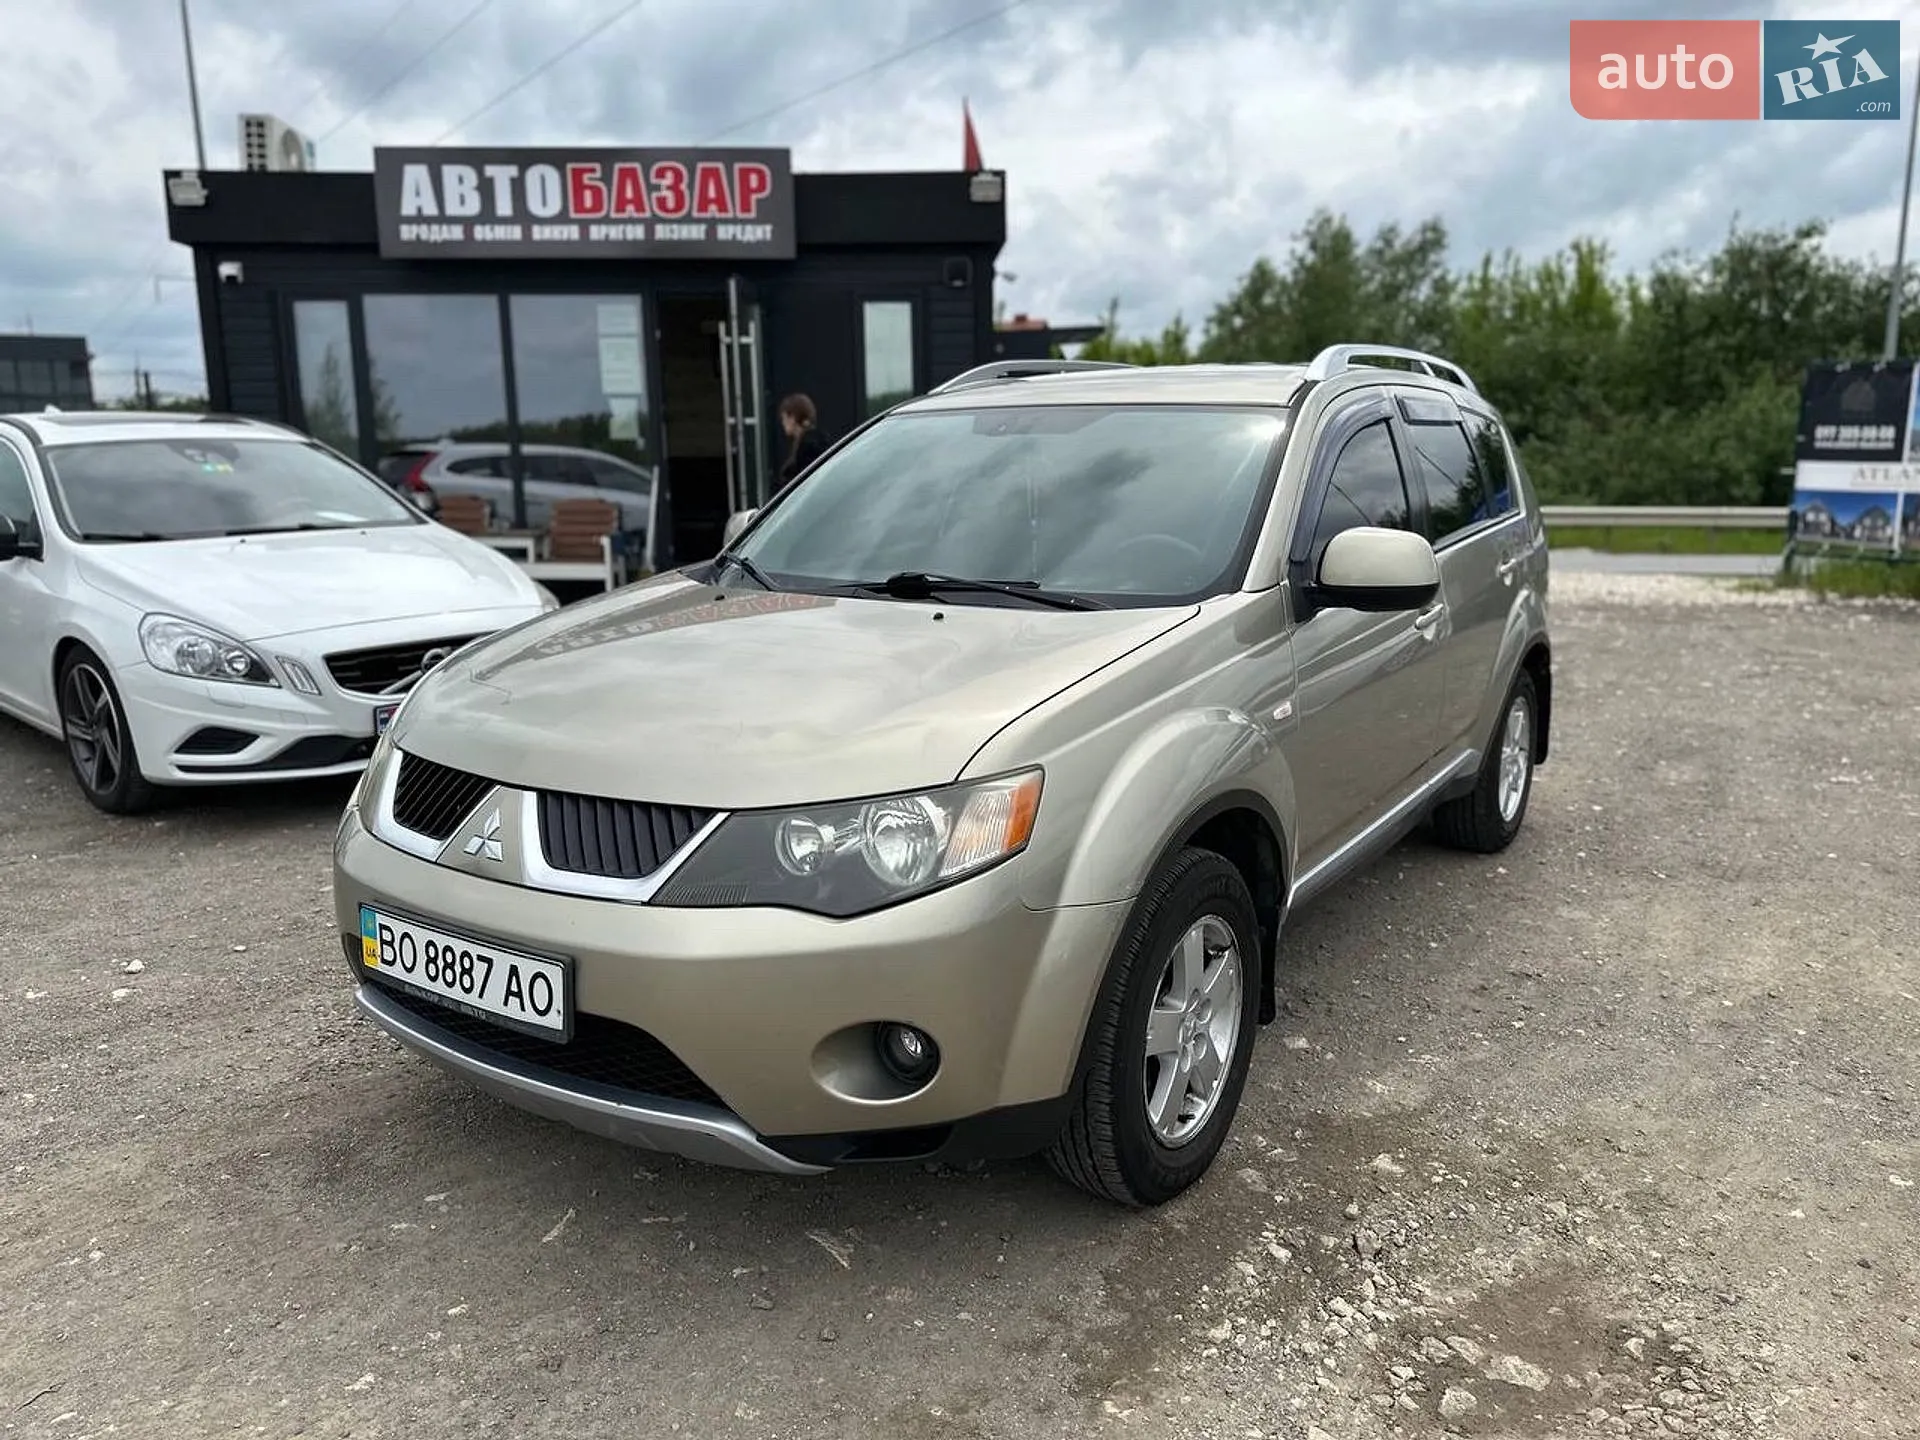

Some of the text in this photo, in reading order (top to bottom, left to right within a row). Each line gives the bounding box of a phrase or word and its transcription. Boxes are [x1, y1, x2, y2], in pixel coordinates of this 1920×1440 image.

[400, 161, 772, 219] АВТОБАЗАР
[399, 224, 465, 243] ПРОДАЖ
[716, 224, 773, 244] КРЕДИТ
[378, 922, 417, 974] BO
[424, 939, 494, 998] 8887
[503, 963, 554, 1017] AO
